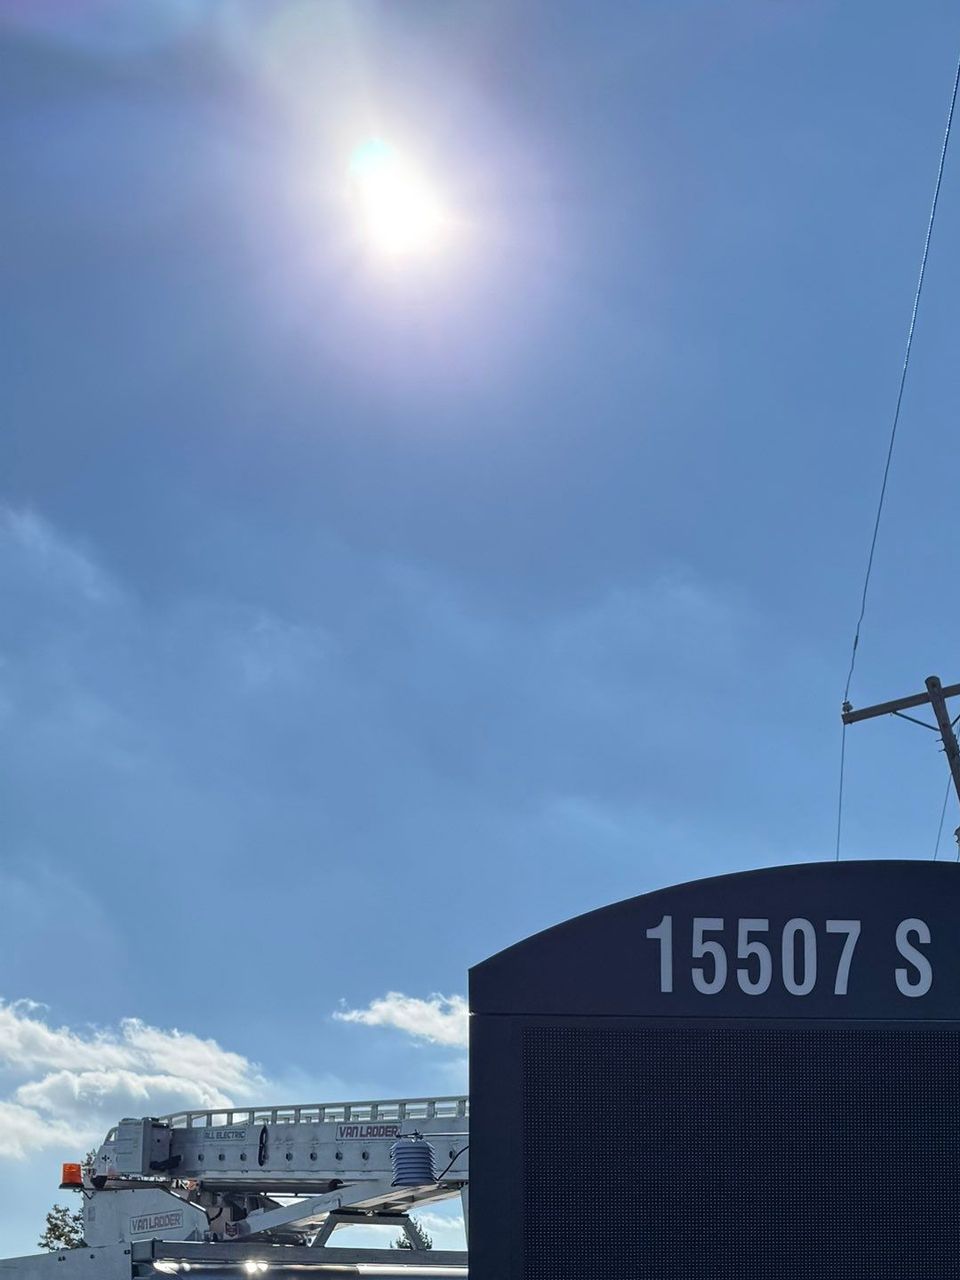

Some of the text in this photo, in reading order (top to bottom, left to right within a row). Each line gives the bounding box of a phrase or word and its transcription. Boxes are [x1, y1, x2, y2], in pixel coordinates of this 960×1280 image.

[645, 915, 862, 996] 15507
[894, 917, 934, 998] S
[339, 1125, 400, 1138] VAN LADDER
[132, 1214, 181, 1231] VAN LADDER
